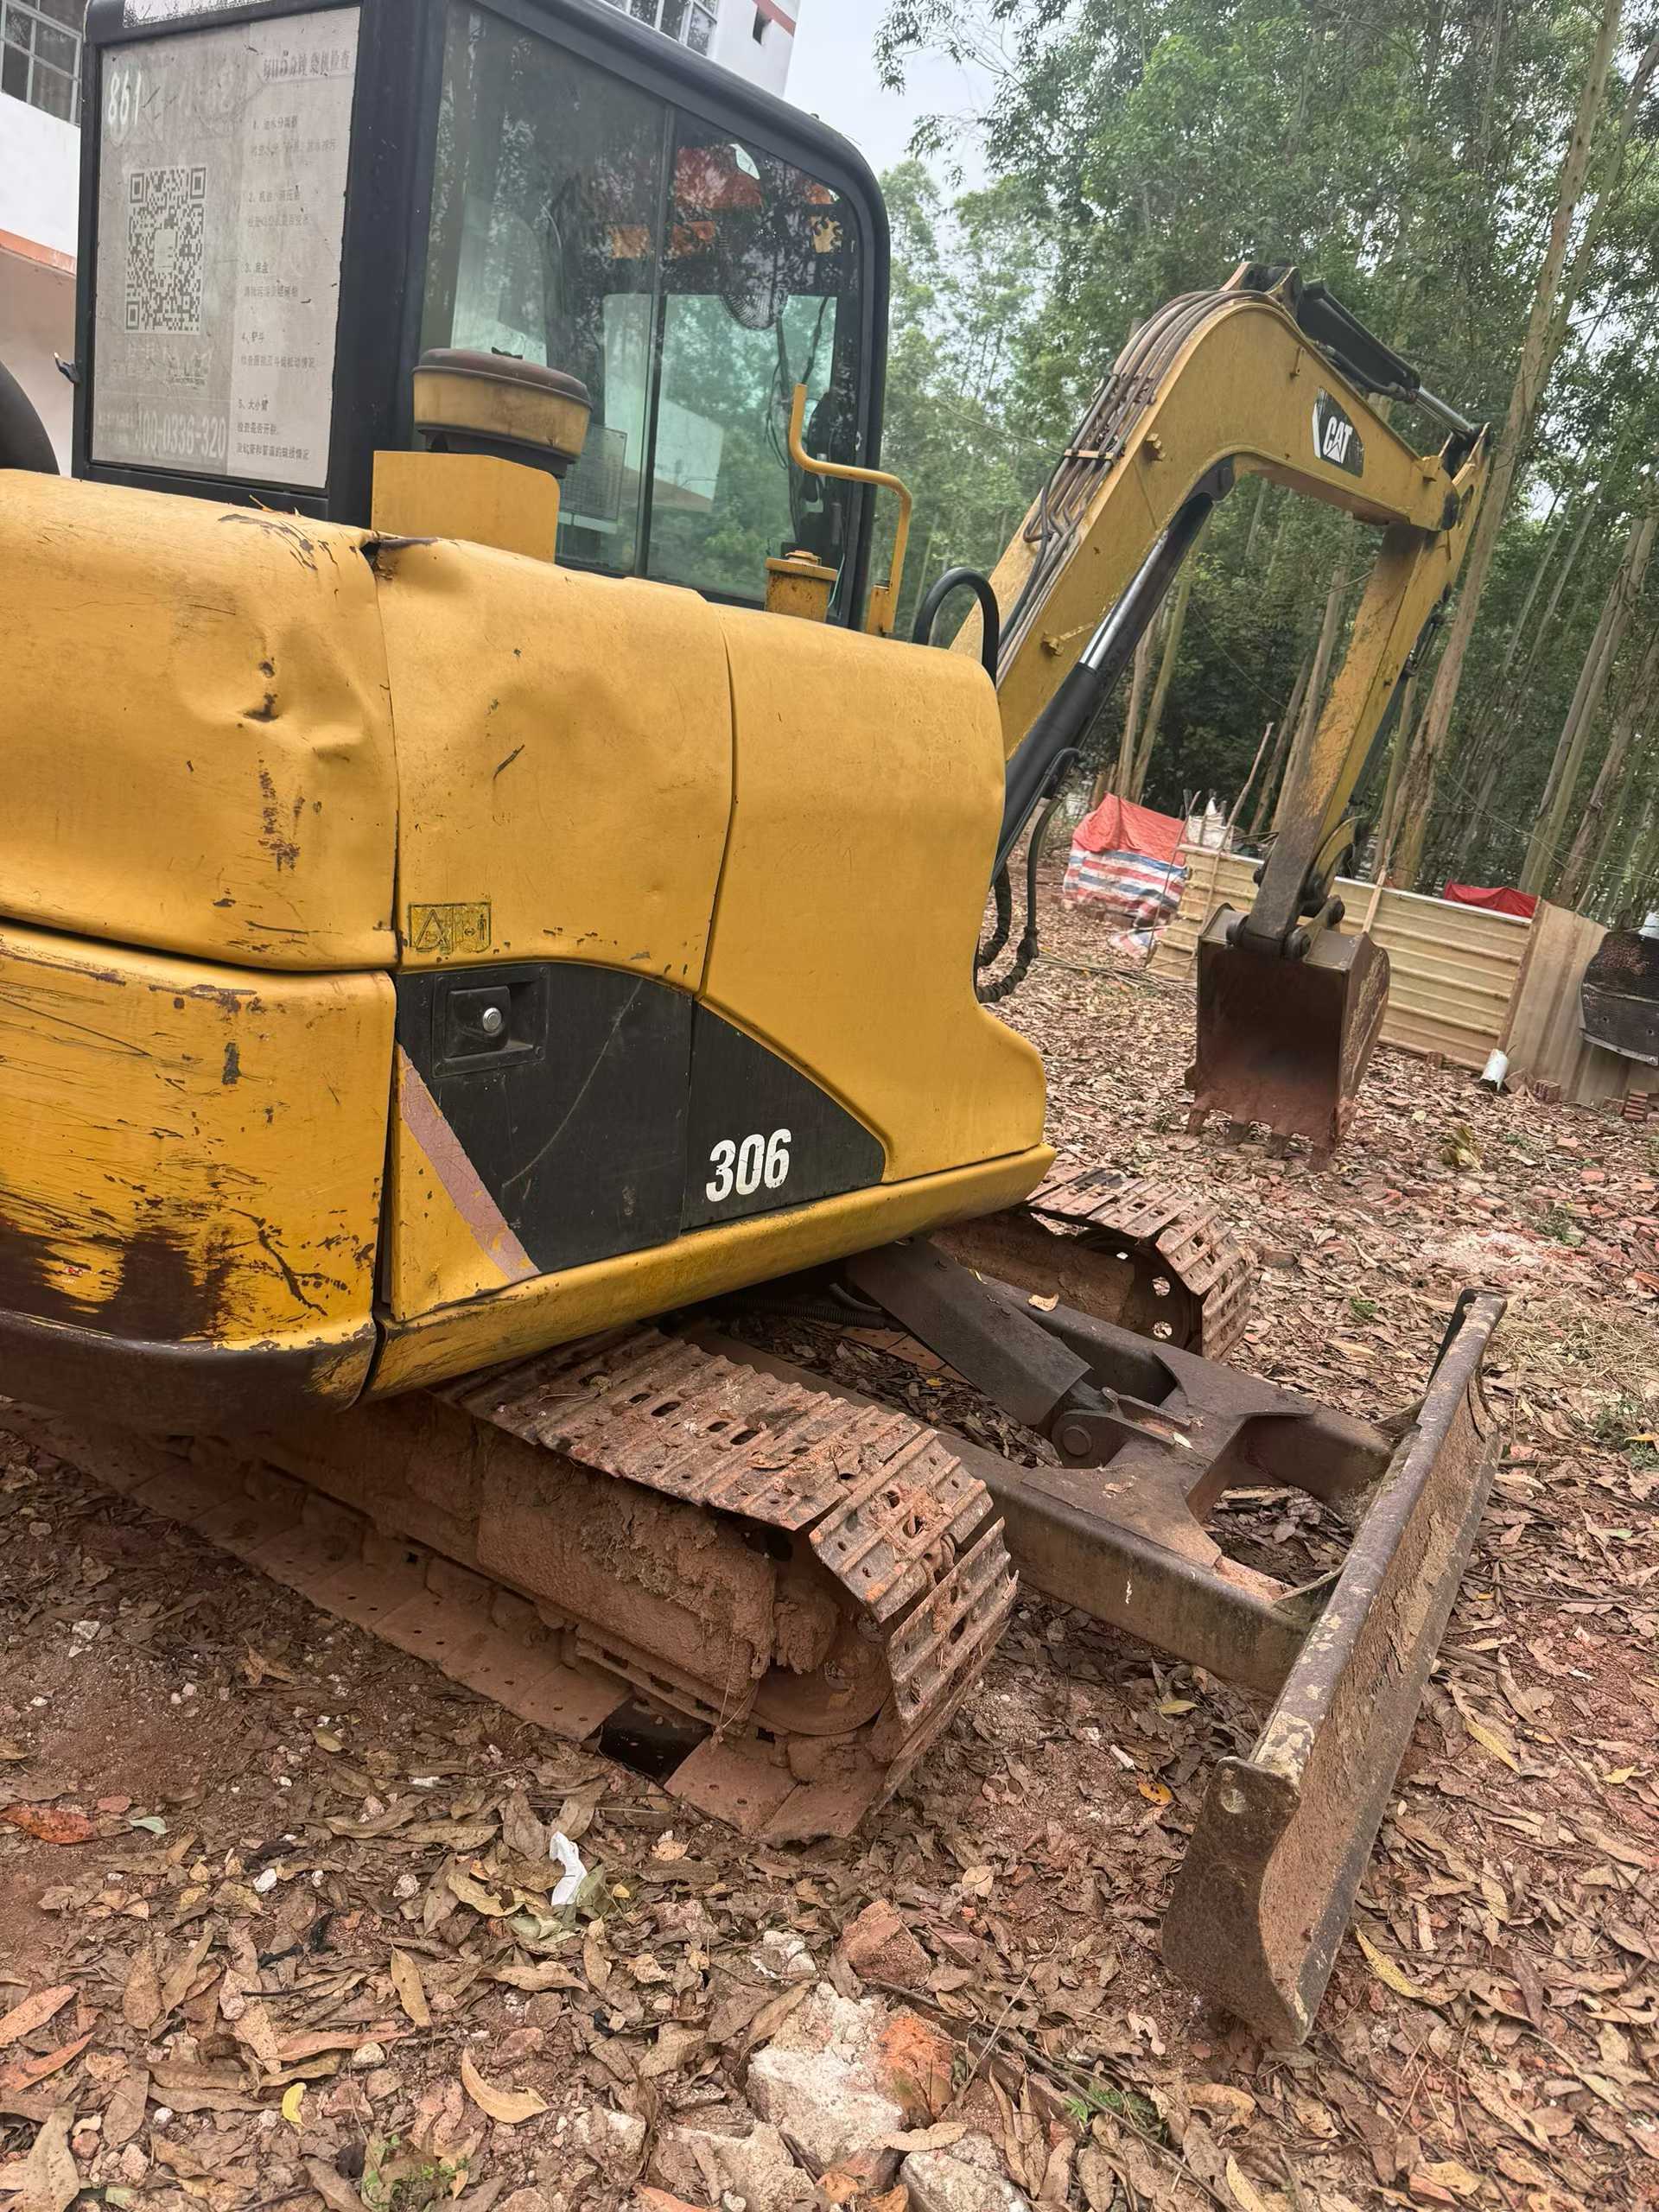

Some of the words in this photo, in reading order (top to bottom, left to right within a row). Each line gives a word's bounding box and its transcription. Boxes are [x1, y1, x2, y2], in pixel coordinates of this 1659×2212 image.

[108, 69, 142, 124] 861
[1323, 416, 1353, 463] CAT
[705, 1128, 792, 1202] 306
